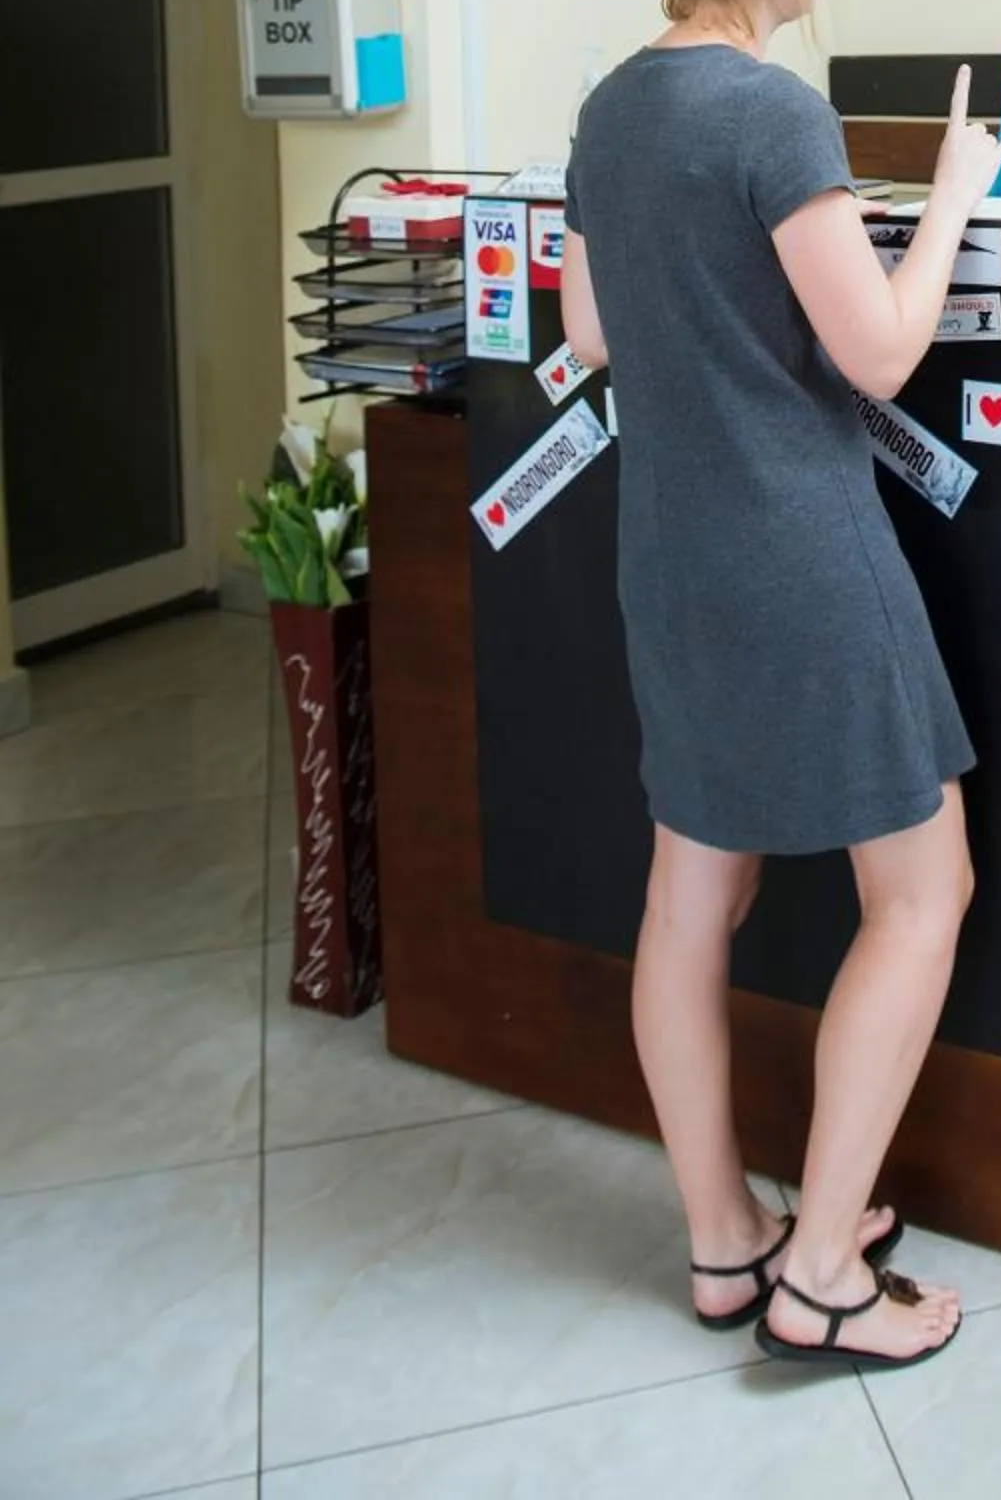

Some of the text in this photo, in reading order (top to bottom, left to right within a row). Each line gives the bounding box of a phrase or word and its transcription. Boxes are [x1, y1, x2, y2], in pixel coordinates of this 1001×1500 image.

[265, 21, 313, 44] BOX
[473, 220, 516, 242] VISA
[966, 393, 972, 426] I
[851, 390, 935, 478] ORONGORO
[501, 434, 578, 517] NGORONGORO
